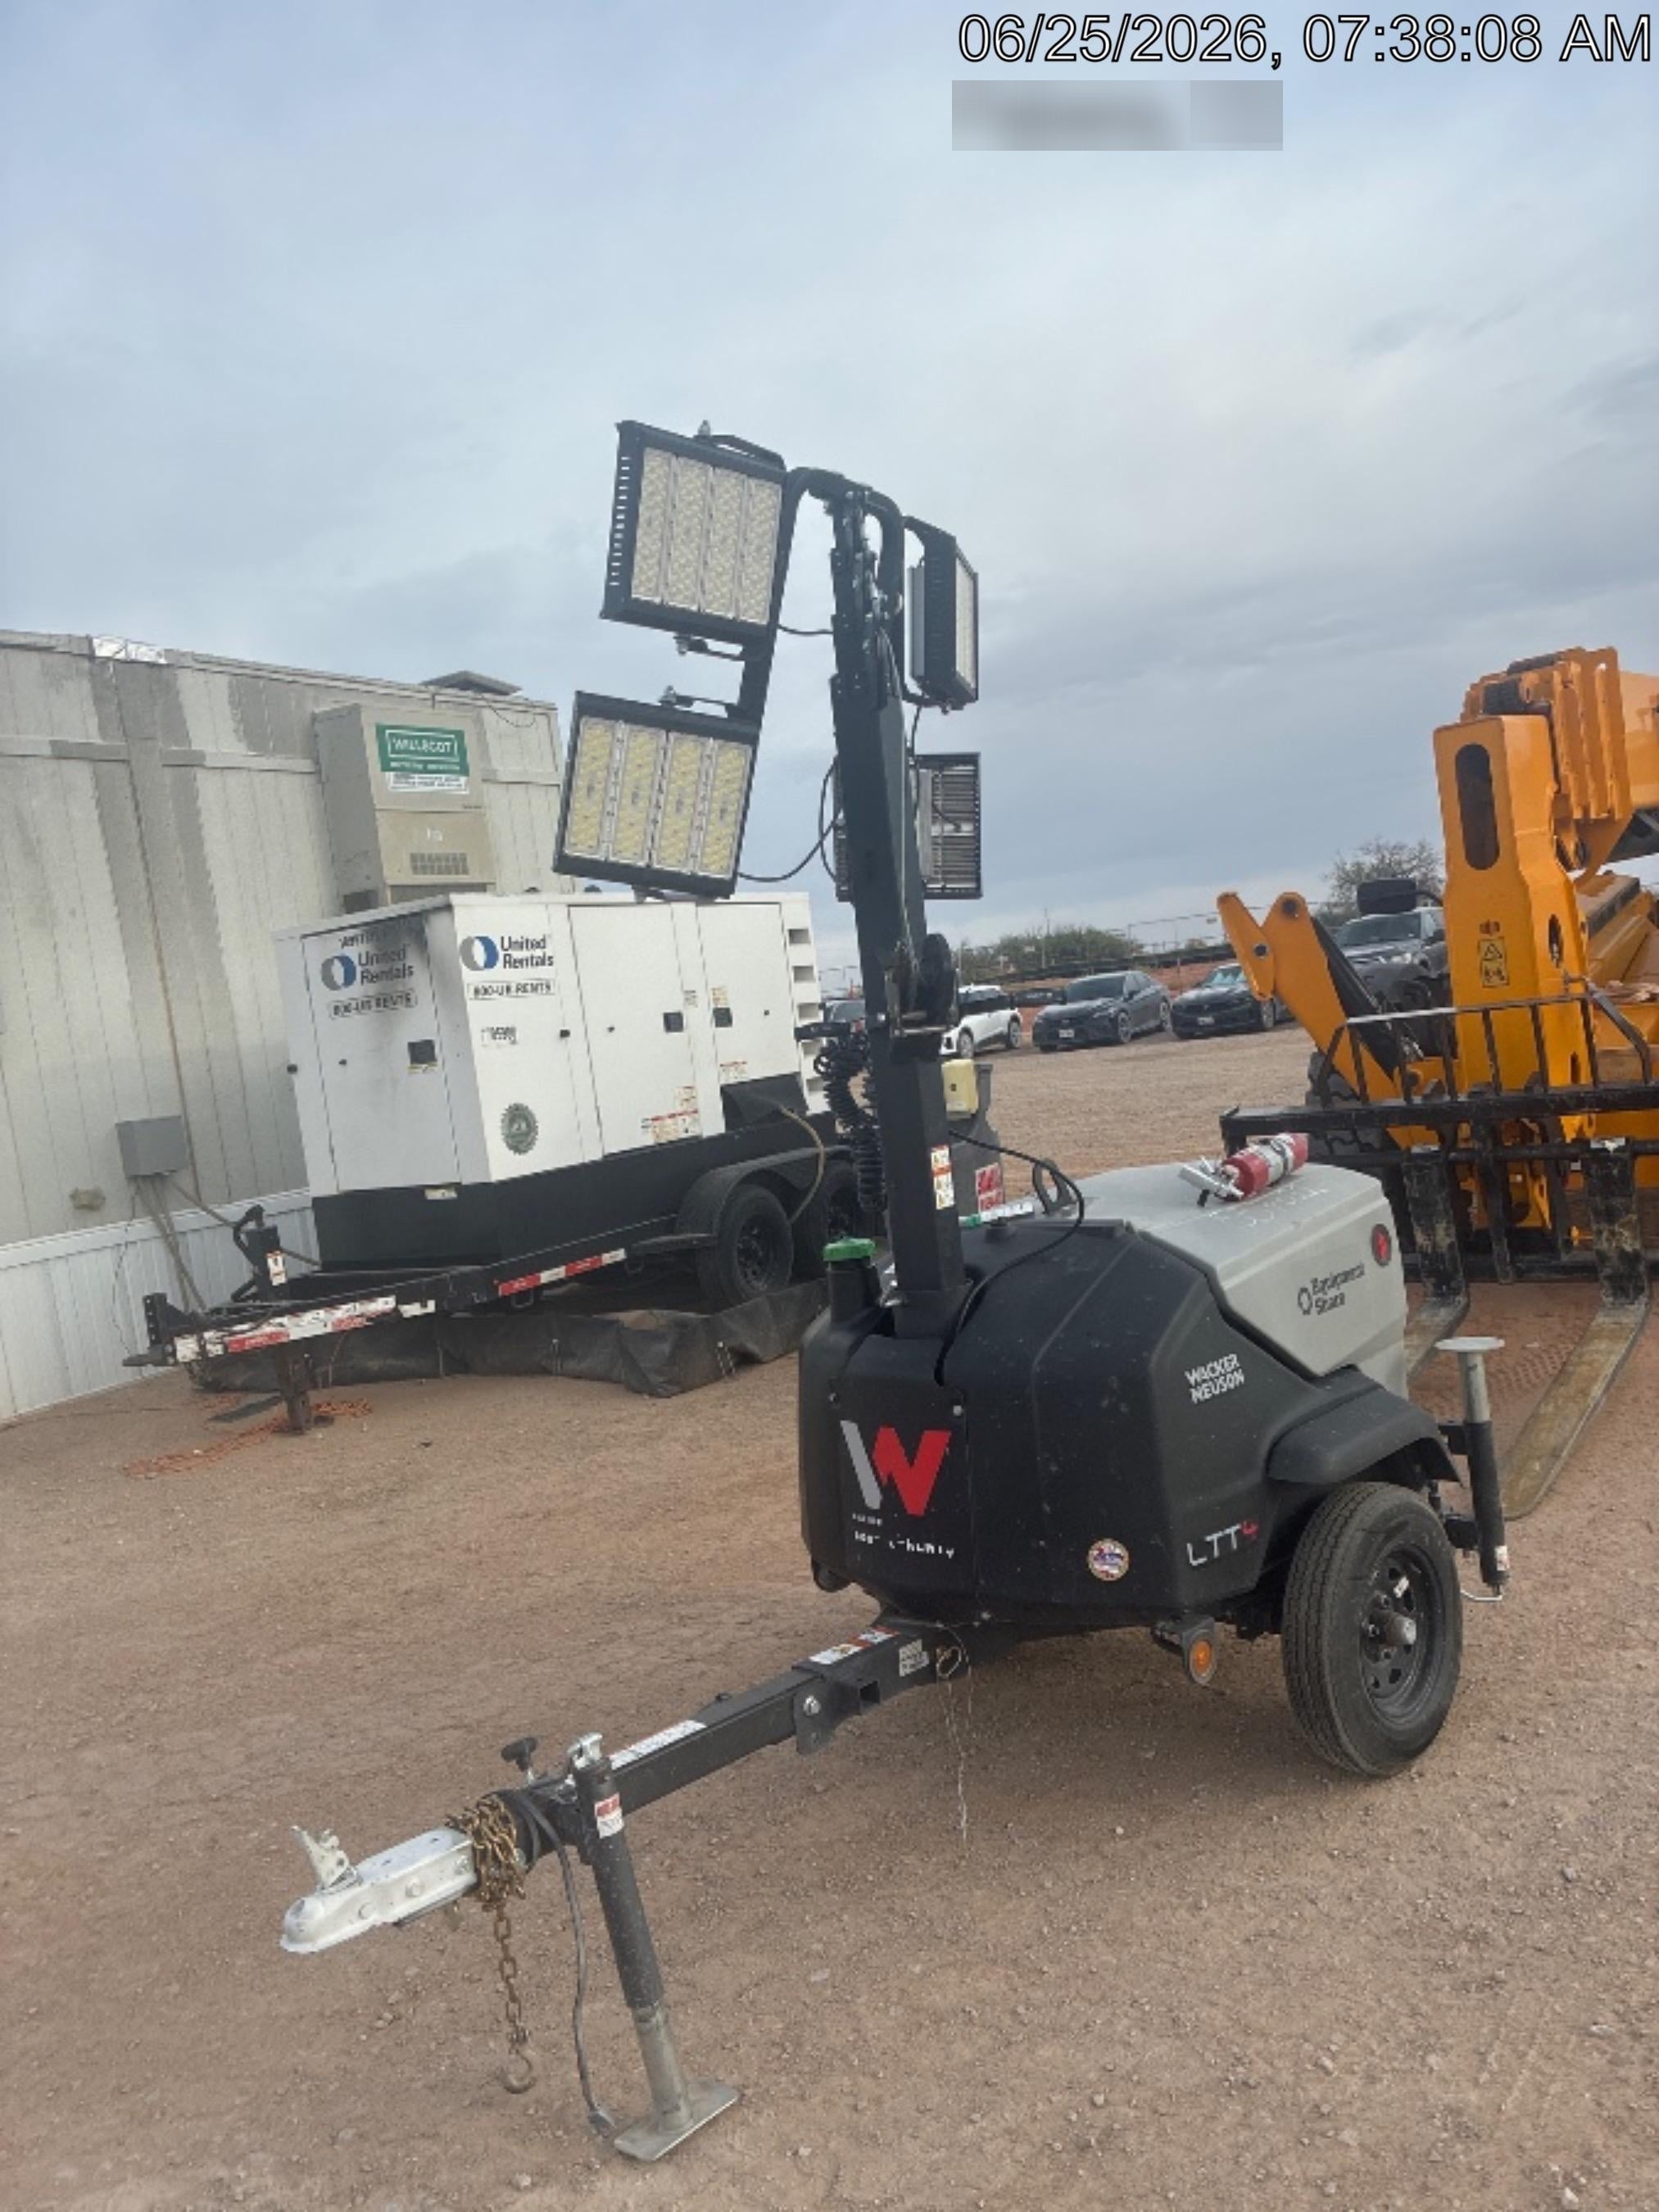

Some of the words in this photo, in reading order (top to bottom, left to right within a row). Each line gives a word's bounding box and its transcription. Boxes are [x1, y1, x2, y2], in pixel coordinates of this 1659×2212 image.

[500, 933, 547, 952] United
[502, 952, 554, 969] Rentals
[1184, 1353, 1240, 1387] WACKER
[1188, 1368, 1245, 1405] NEUSON
